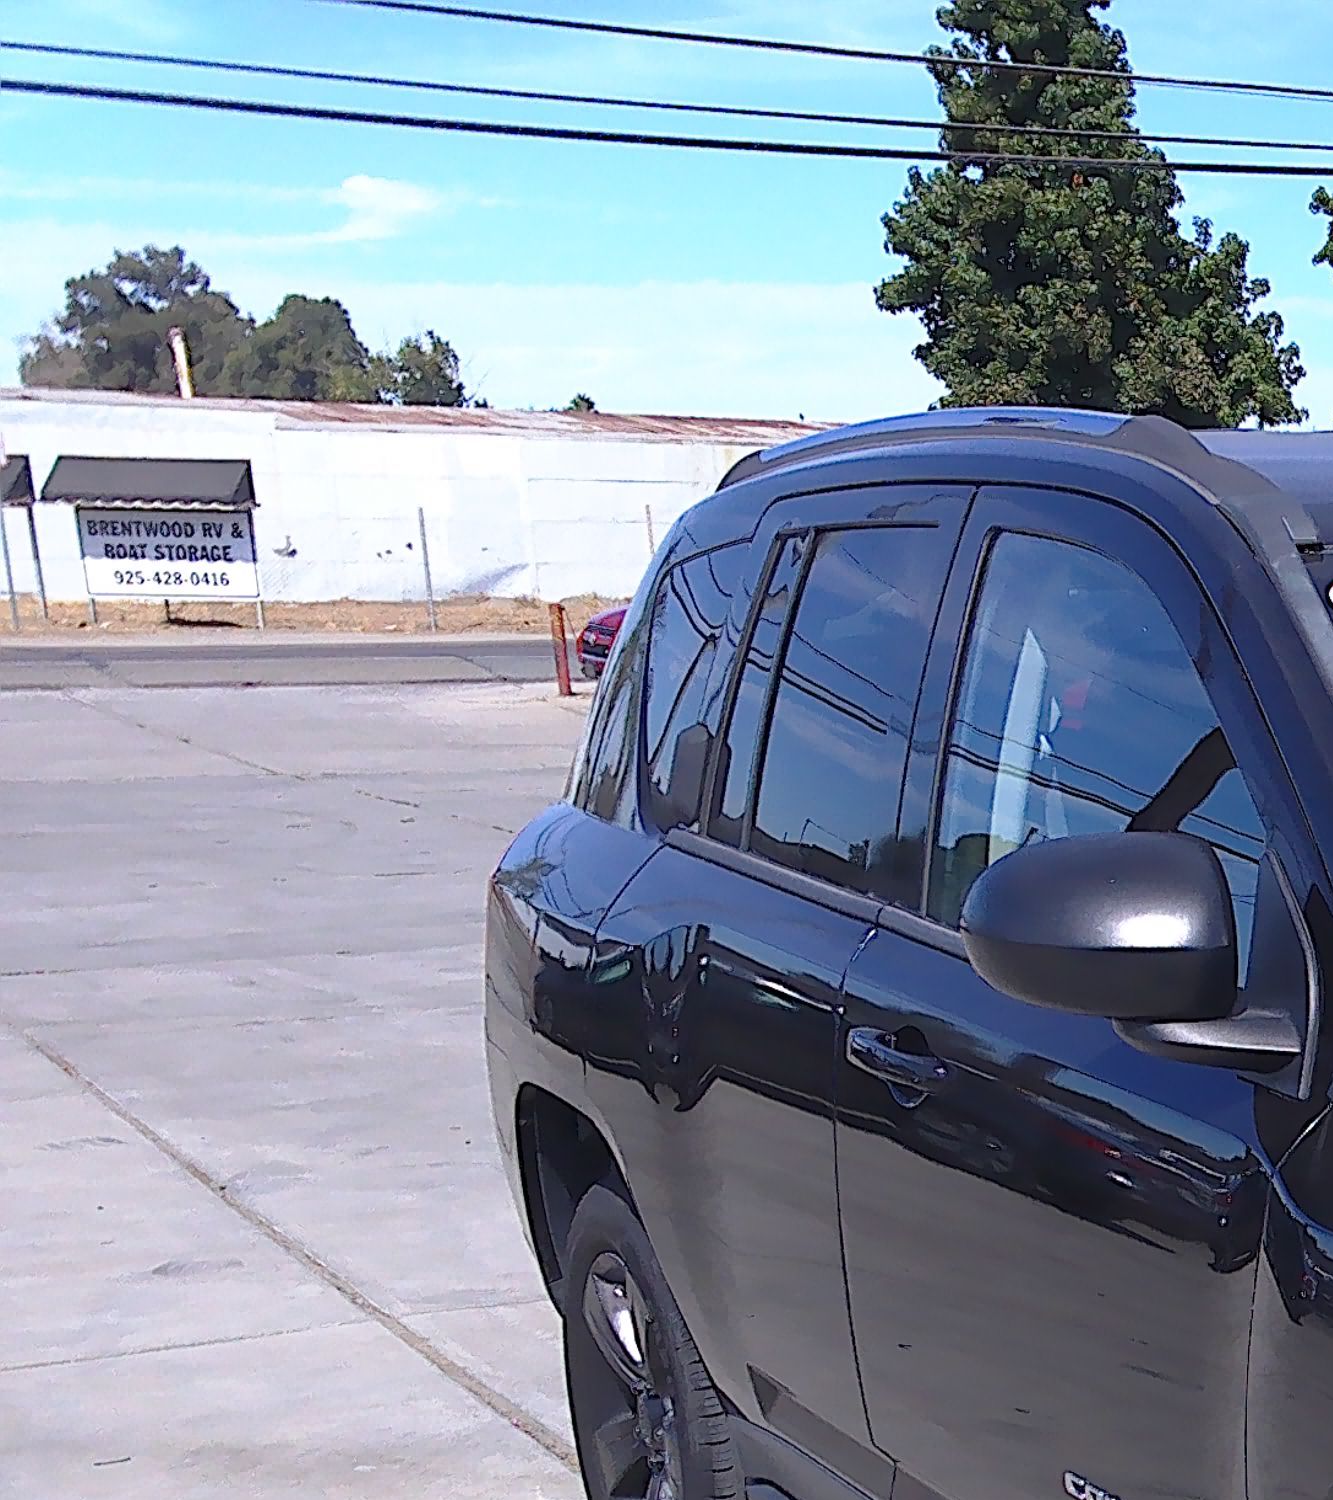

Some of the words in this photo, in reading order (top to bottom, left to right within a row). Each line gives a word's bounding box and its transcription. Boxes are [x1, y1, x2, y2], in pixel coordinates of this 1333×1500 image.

[87, 520, 195, 538] BRENTWOOD
[202, 522, 223, 538] RV
[231, 522, 245, 538] &
[104, 543, 148, 561] BOAT
[155, 544, 233, 562] STORAGE
[113, 570, 230, 587] 925-428-0416
